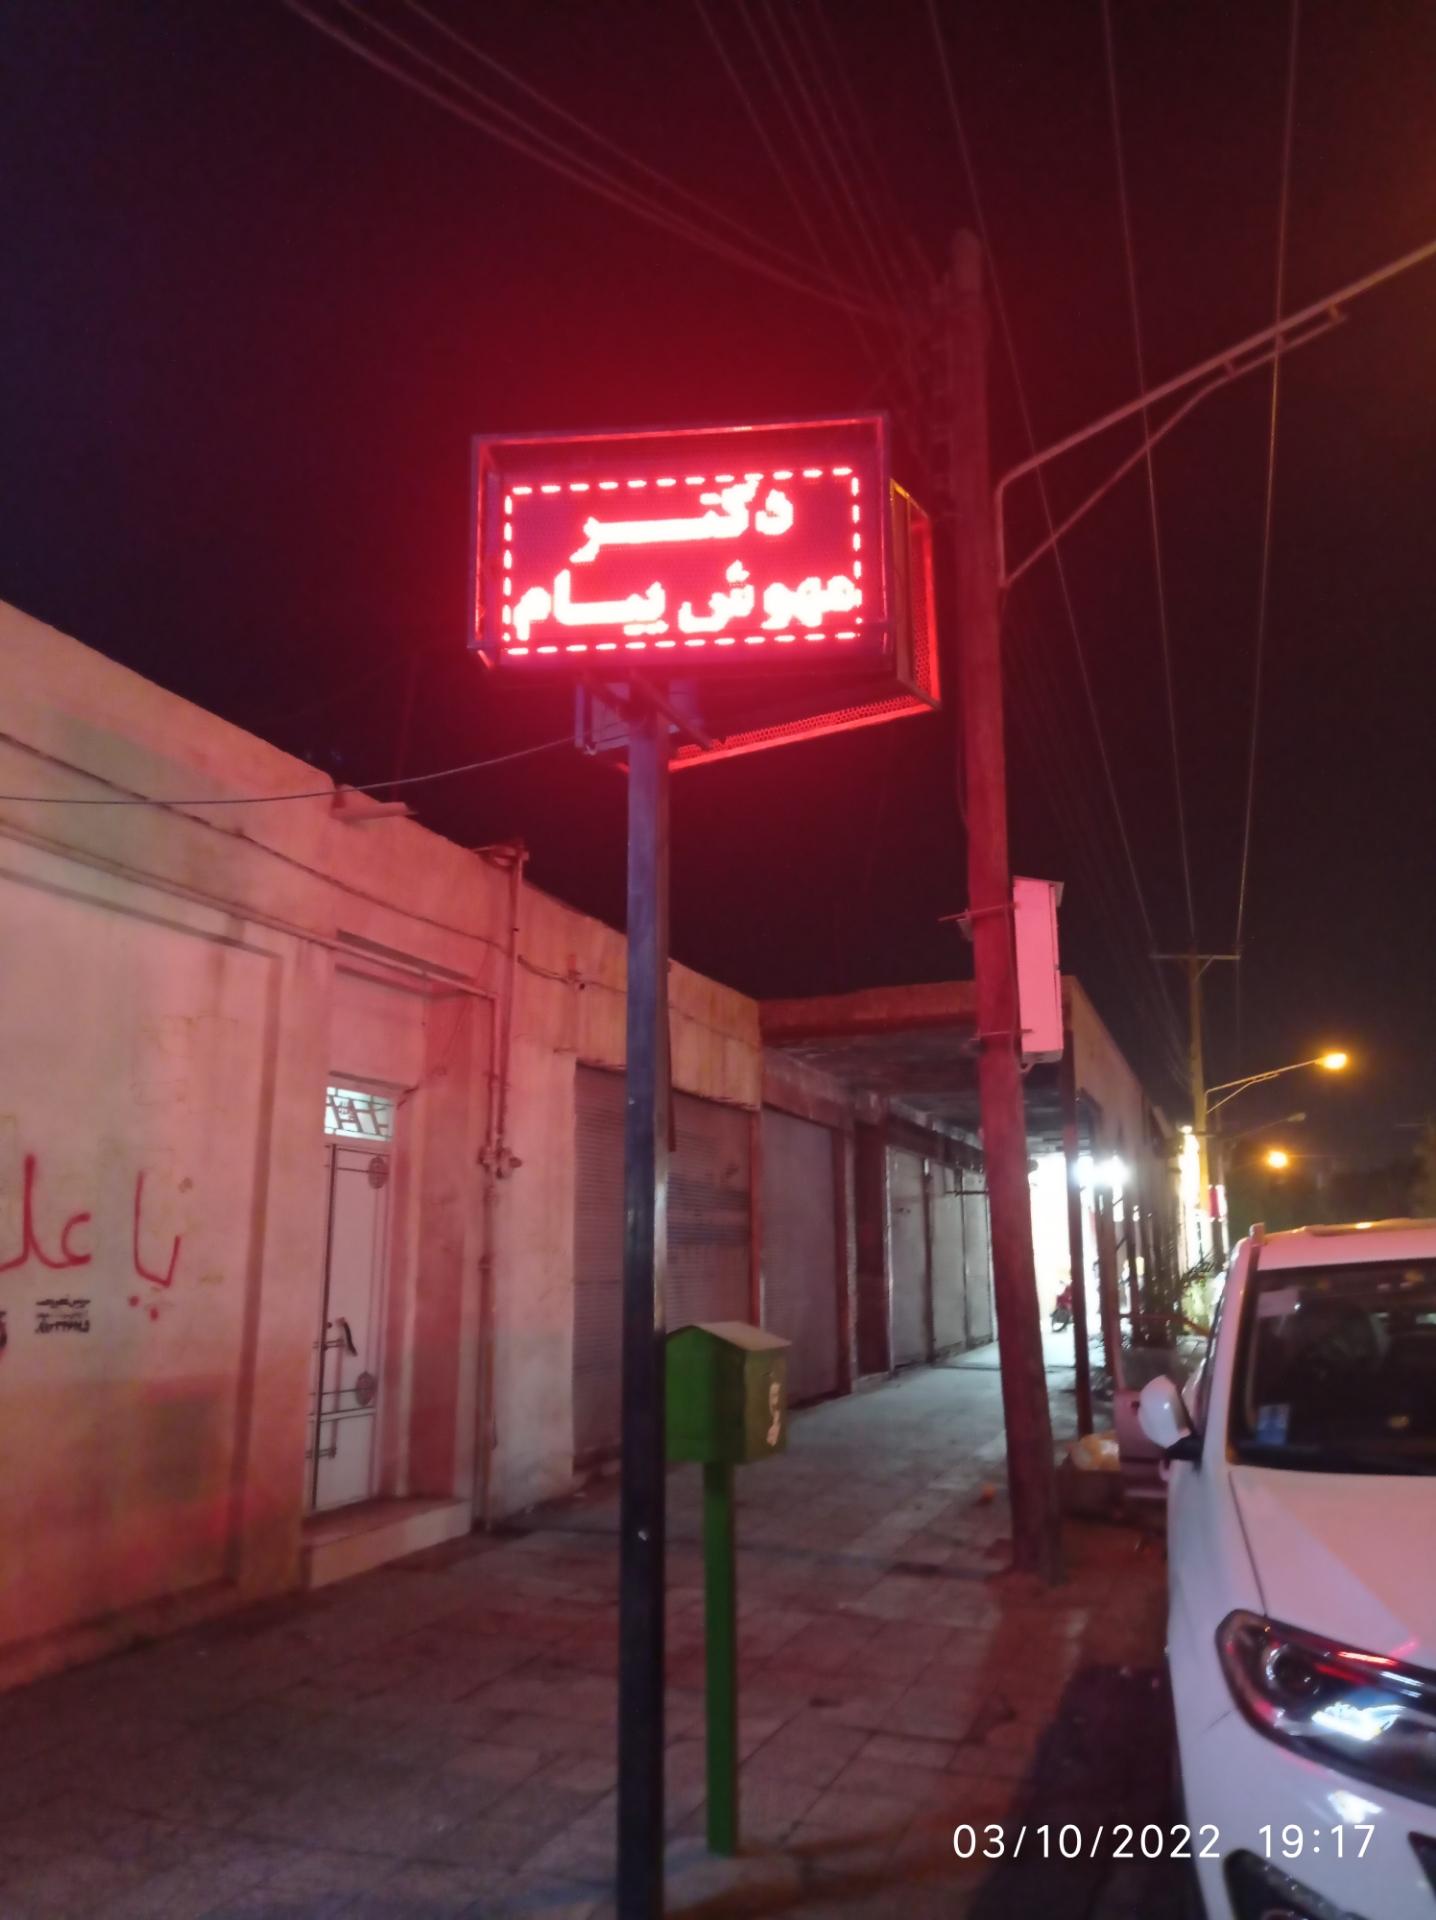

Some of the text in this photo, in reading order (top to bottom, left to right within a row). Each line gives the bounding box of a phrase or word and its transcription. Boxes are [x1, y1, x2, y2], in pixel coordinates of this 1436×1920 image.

[569, 479, 794, 563] دکتر
[677, 560, 858, 634] مهوش
[0, 1154, 92, 1273] عل
